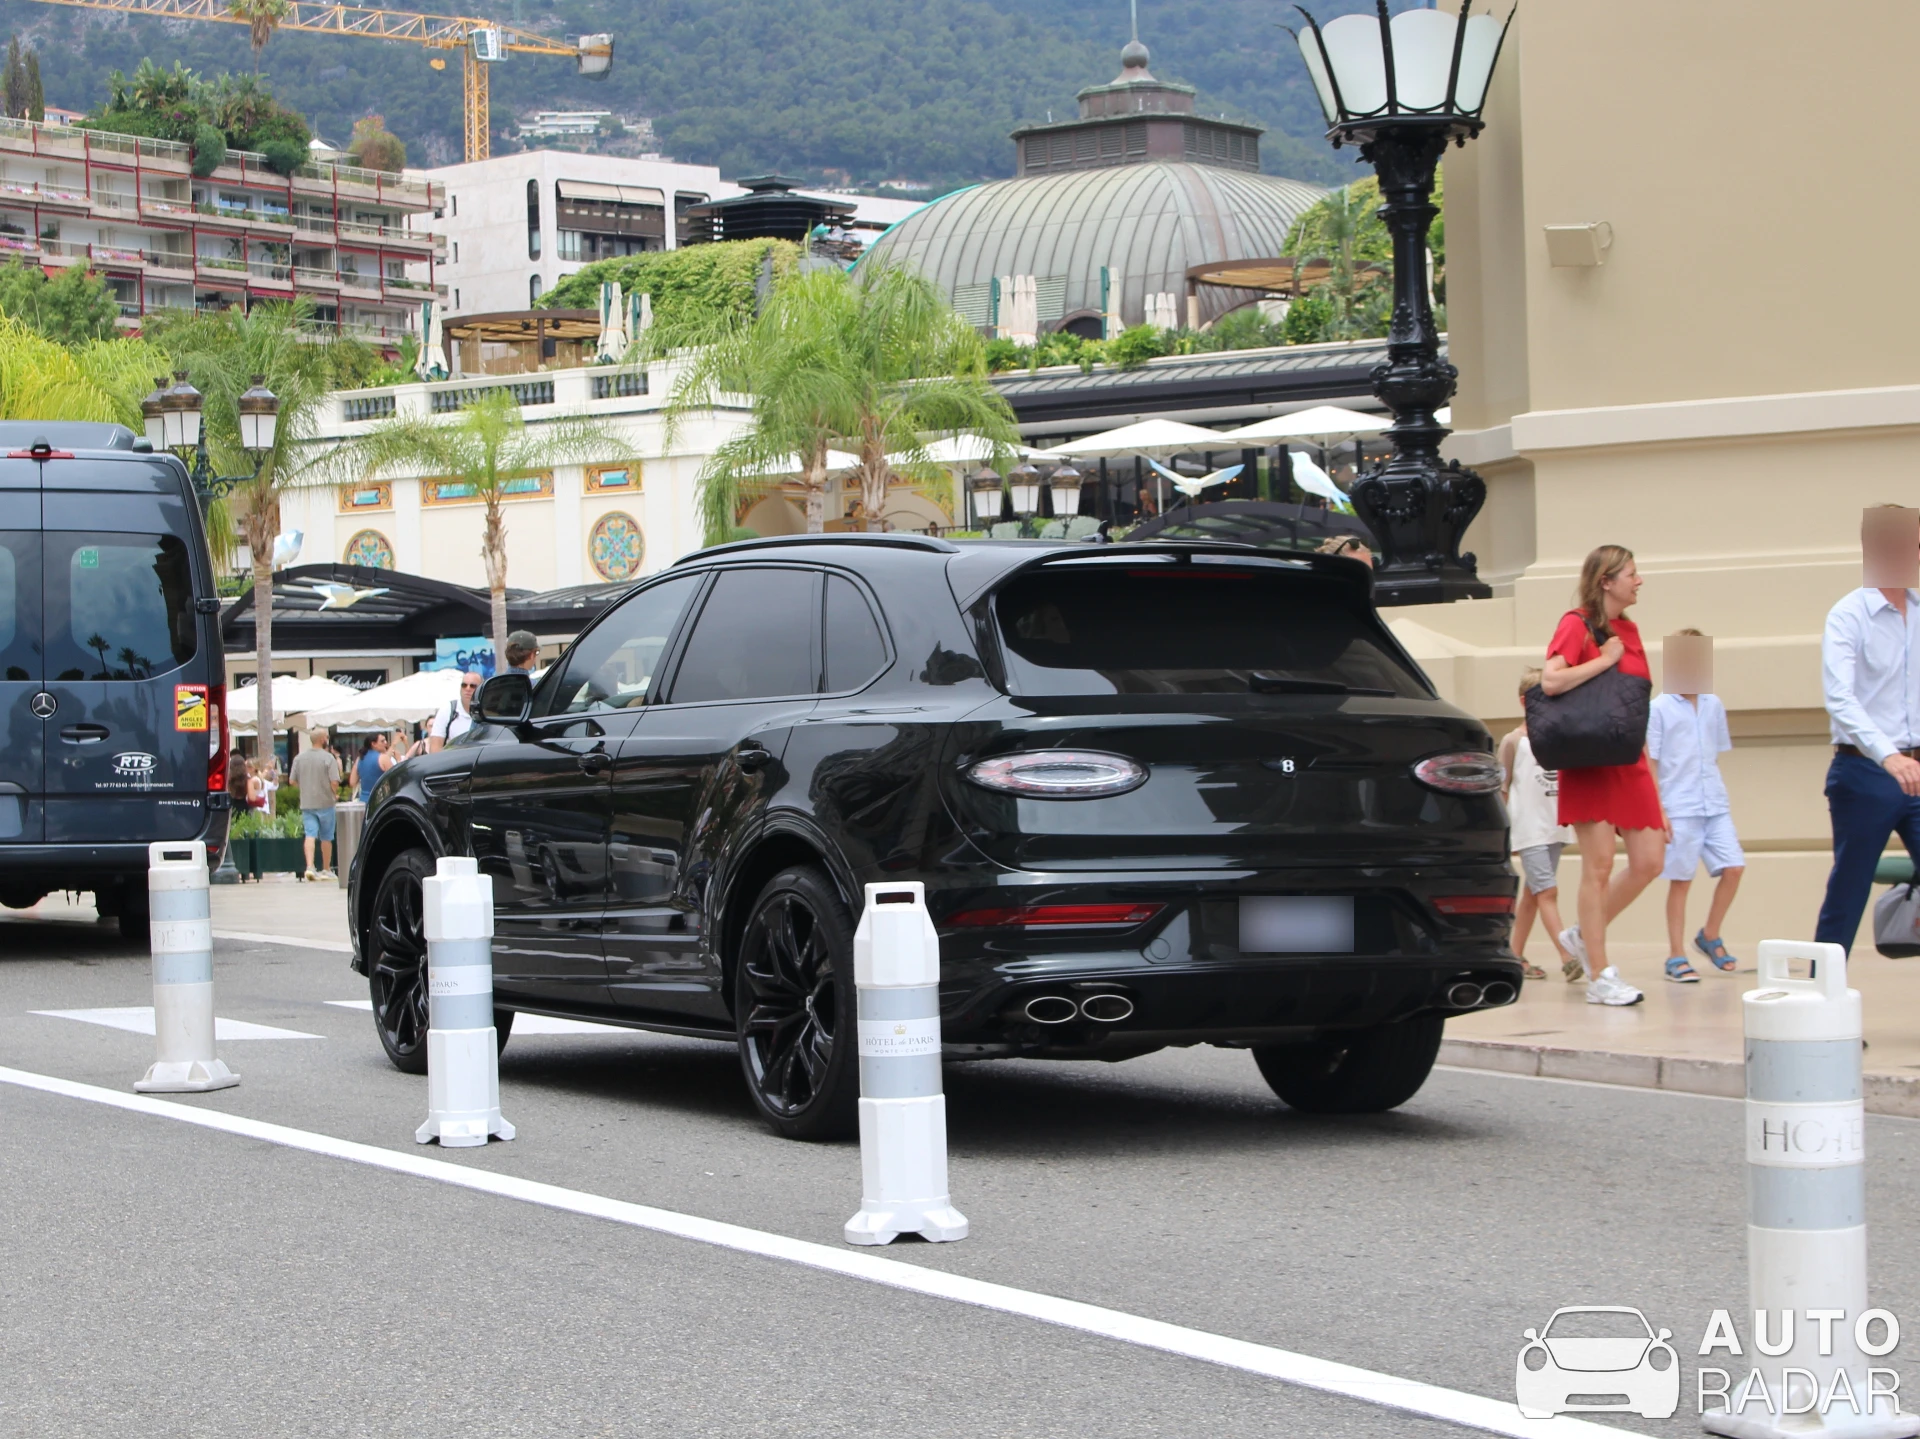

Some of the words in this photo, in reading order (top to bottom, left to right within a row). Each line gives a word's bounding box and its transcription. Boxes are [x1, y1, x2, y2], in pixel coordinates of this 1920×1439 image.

[456, 648, 494, 666] CASI
[120, 756, 152, 767] RTS
[865, 1037, 897, 1046] HÔTEL
[909, 1036, 934, 1045] PARIS
